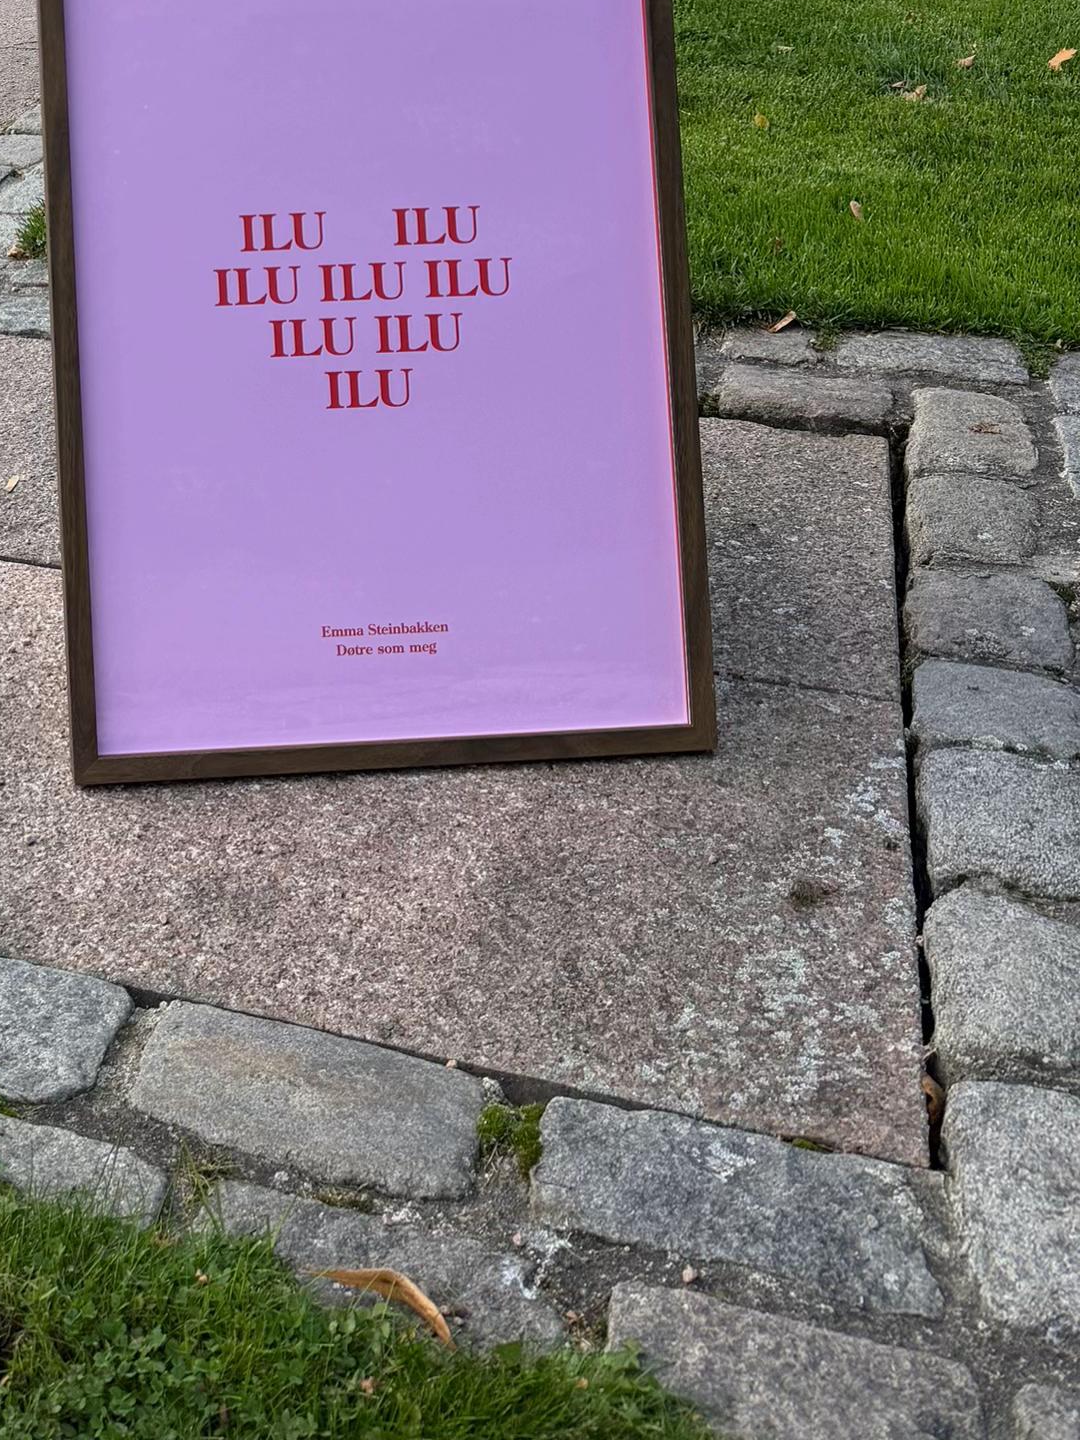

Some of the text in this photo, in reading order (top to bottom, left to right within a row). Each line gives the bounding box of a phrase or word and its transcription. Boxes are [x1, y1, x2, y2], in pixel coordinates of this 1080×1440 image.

[239, 206, 480, 252] ILU ILU
[213, 258, 512, 306] ILU ILU ILU
[269, 313, 462, 357] ILU ILU
[325, 369, 413, 409] ILU
[321, 621, 449, 638] Emma Steinbakken
[336, 641, 438, 657] Døtre som meg
